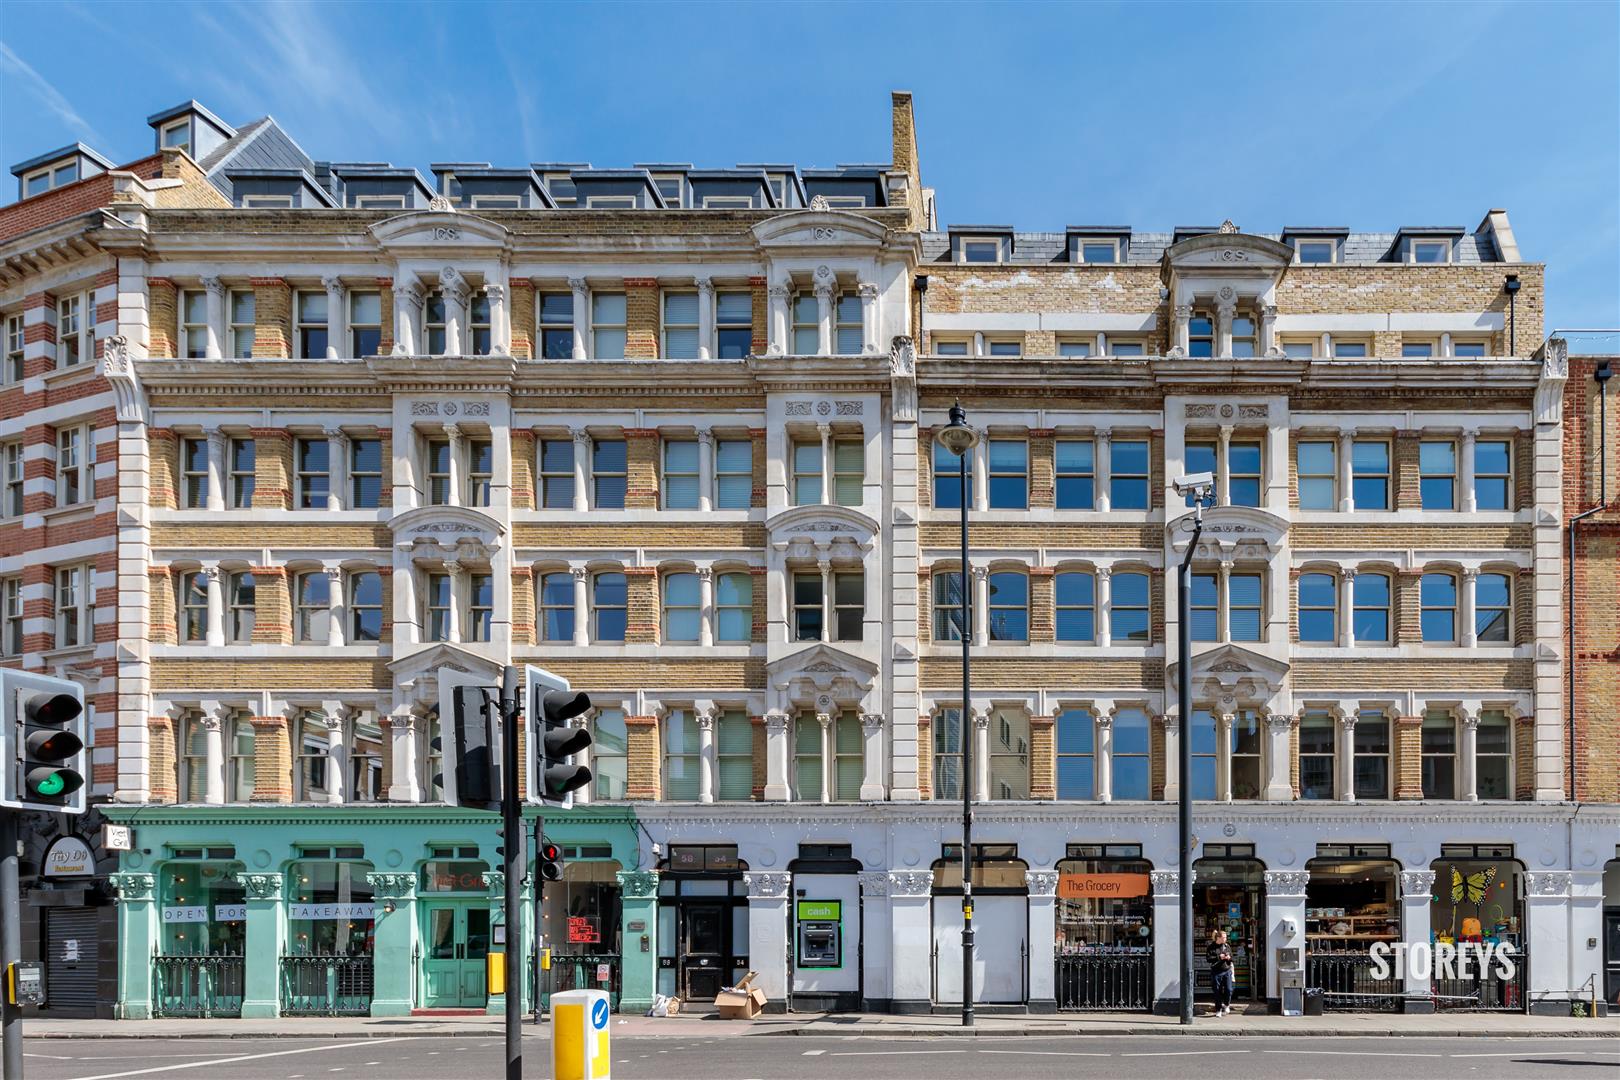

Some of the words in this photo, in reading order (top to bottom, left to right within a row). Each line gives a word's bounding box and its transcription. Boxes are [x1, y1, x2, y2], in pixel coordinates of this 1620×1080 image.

[1066, 880, 1084, 891] The
[1086, 880, 1121, 893] Grocery
[164, 909, 206, 920] OPEN
[218, 908, 247, 918] FOR
[290, 907, 374, 917] TAKEAWAY
[807, 906, 832, 916] cash
